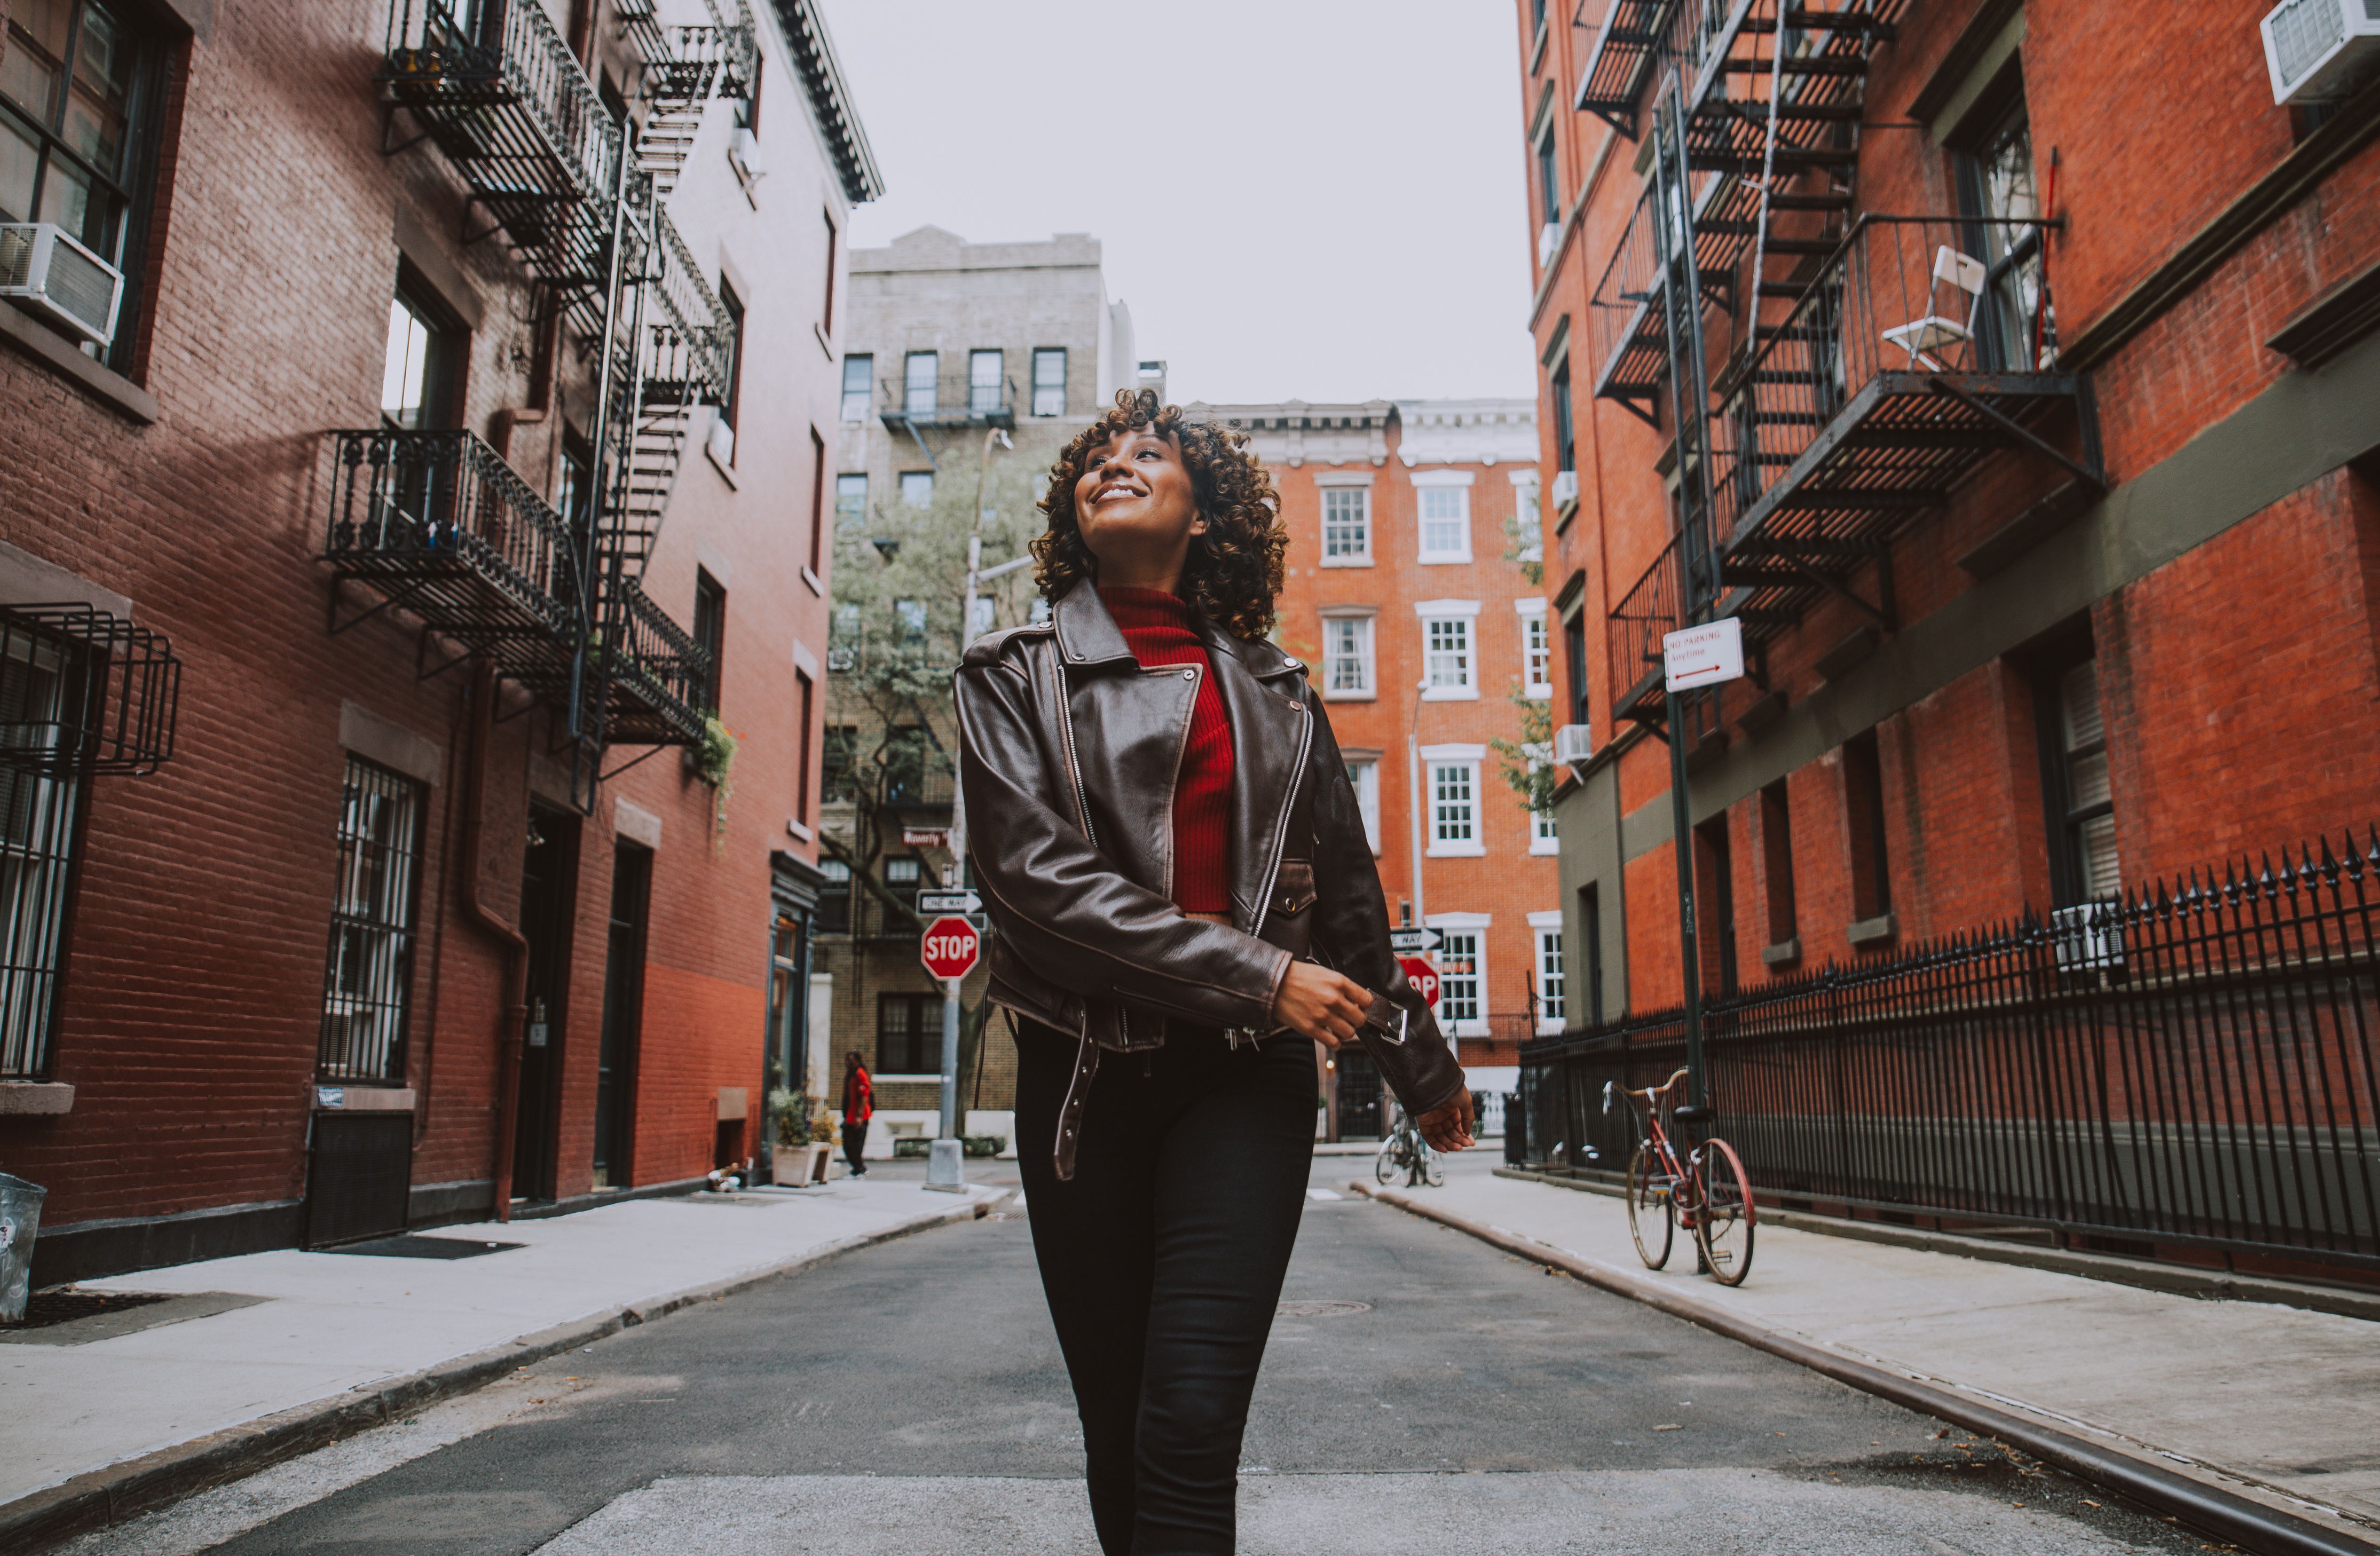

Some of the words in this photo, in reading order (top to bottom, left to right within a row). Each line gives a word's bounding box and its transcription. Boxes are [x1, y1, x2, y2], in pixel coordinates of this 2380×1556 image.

[1670, 641, 1681, 650] NO
[1684, 631, 1720, 646] PARKING
[1671, 649, 1705, 662] Anytime
[926, 935, 976, 960] STOP
[1401, 934, 1421, 944] WAY
[1408, 975, 1437, 1000] OP
